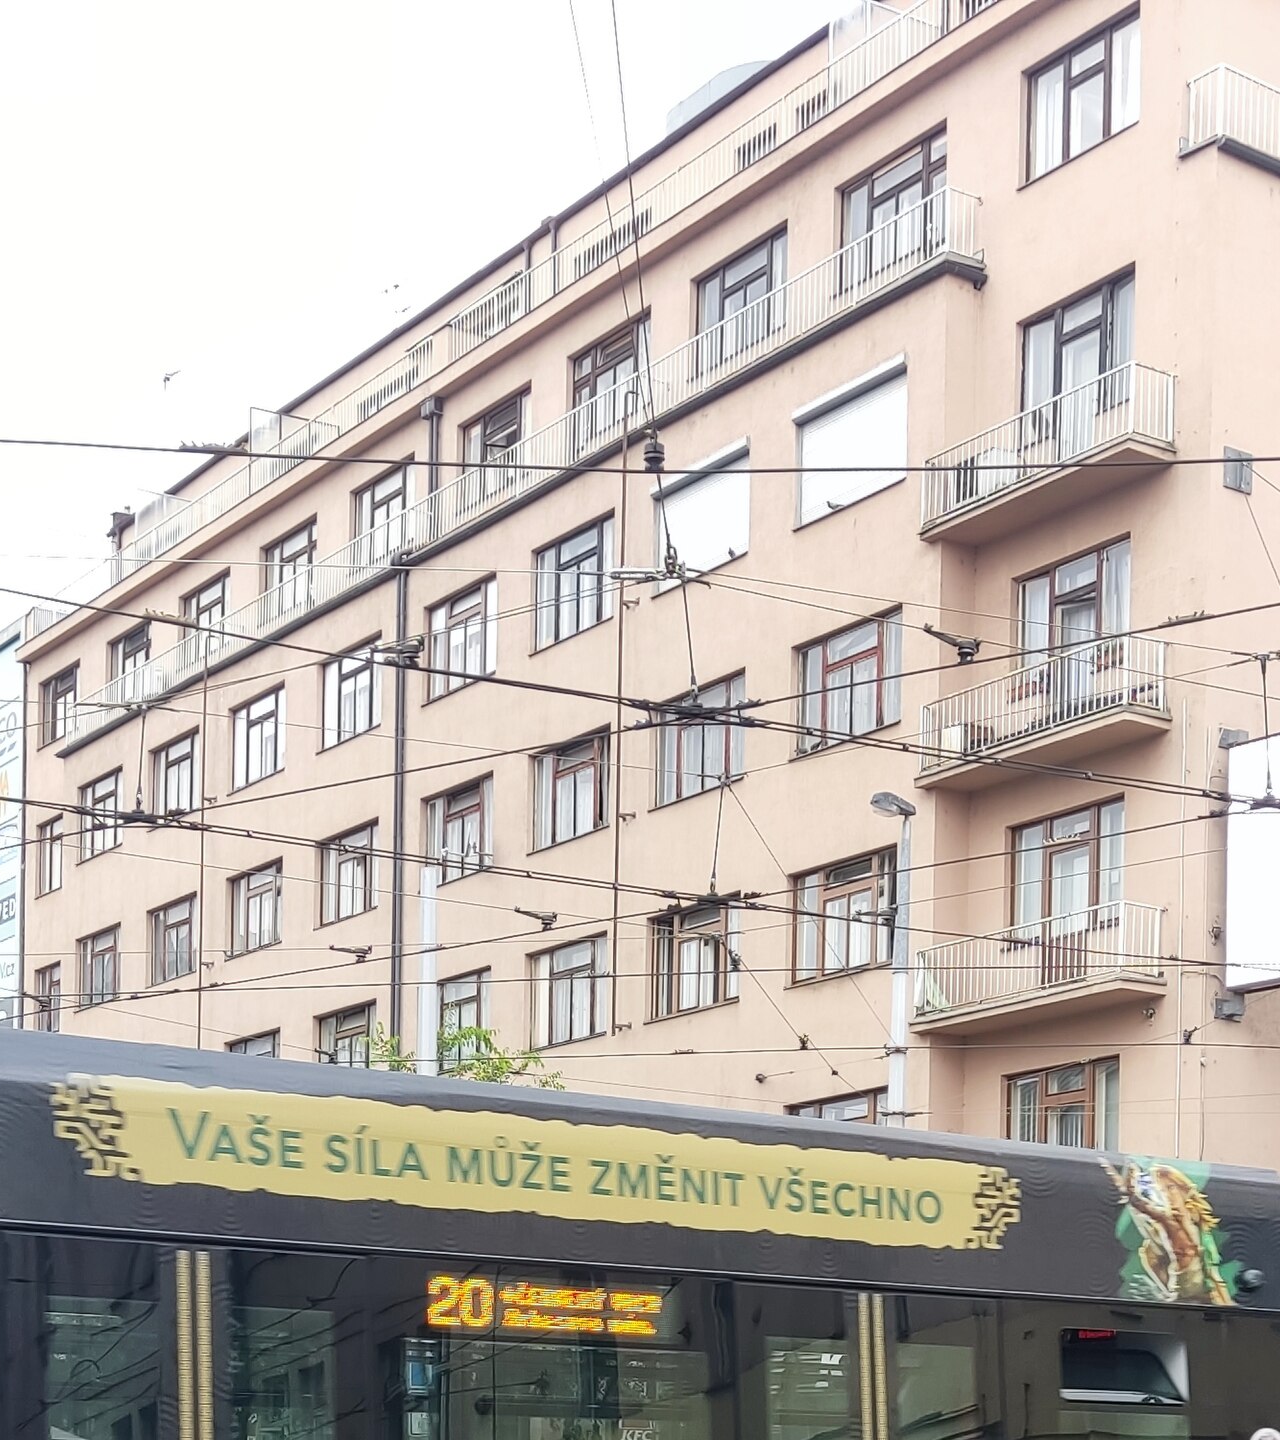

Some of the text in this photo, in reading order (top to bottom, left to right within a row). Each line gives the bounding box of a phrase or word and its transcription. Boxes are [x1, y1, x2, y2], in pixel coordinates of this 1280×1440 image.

[166, 1107, 943, 1226] VAŠE SÍLA MŮŽE ZMĚNIT VŠECHNO
[427, 1276, 494, 1328] 20
